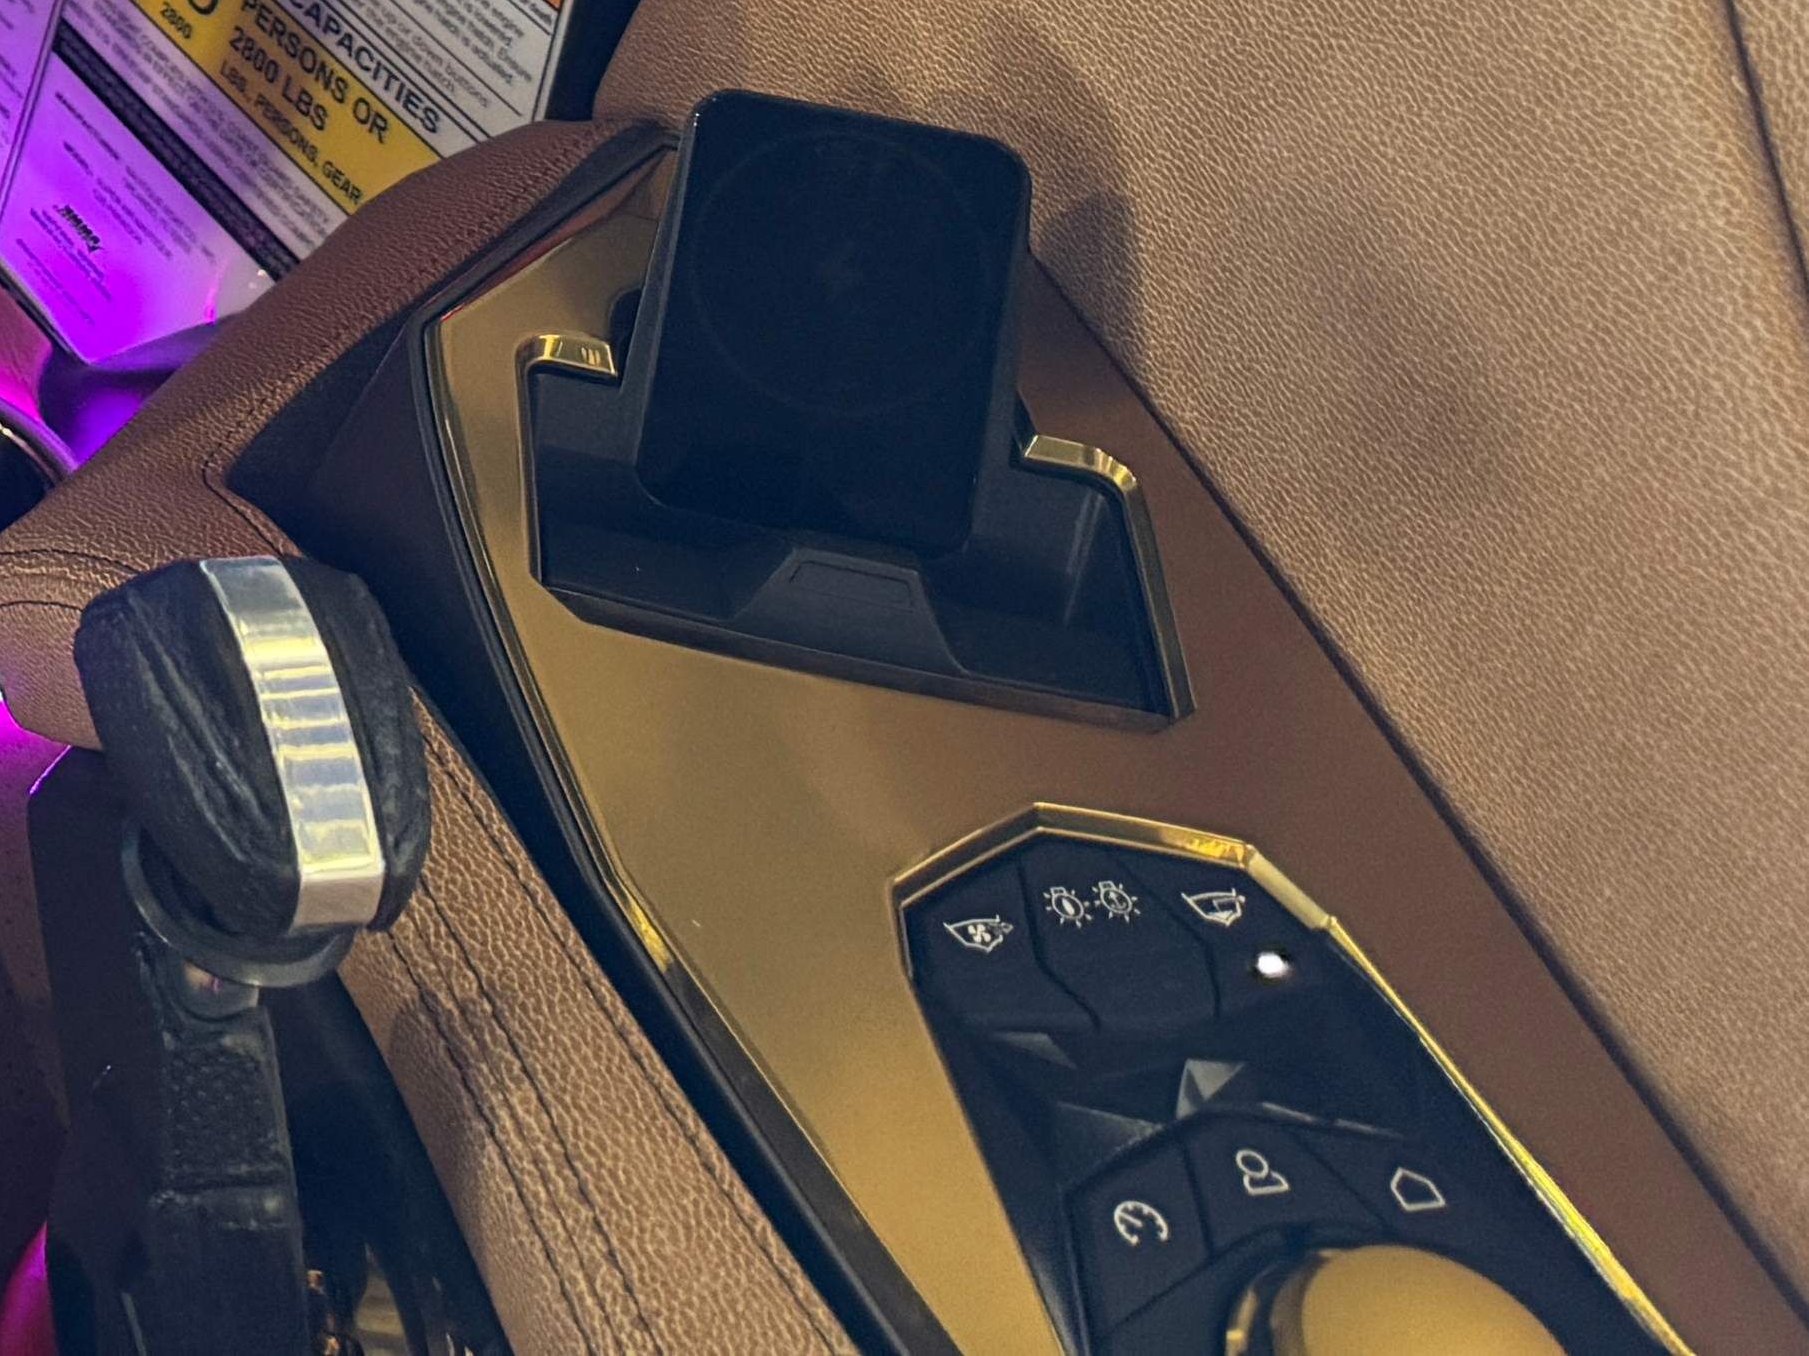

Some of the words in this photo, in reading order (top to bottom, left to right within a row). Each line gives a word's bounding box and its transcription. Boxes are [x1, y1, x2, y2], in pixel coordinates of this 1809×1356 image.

[230, 26, 279, 83] 2800
[282, 75, 328, 131] LBS
[352, 97, 389, 144] OR
[322, 160, 363, 205] GEAR
